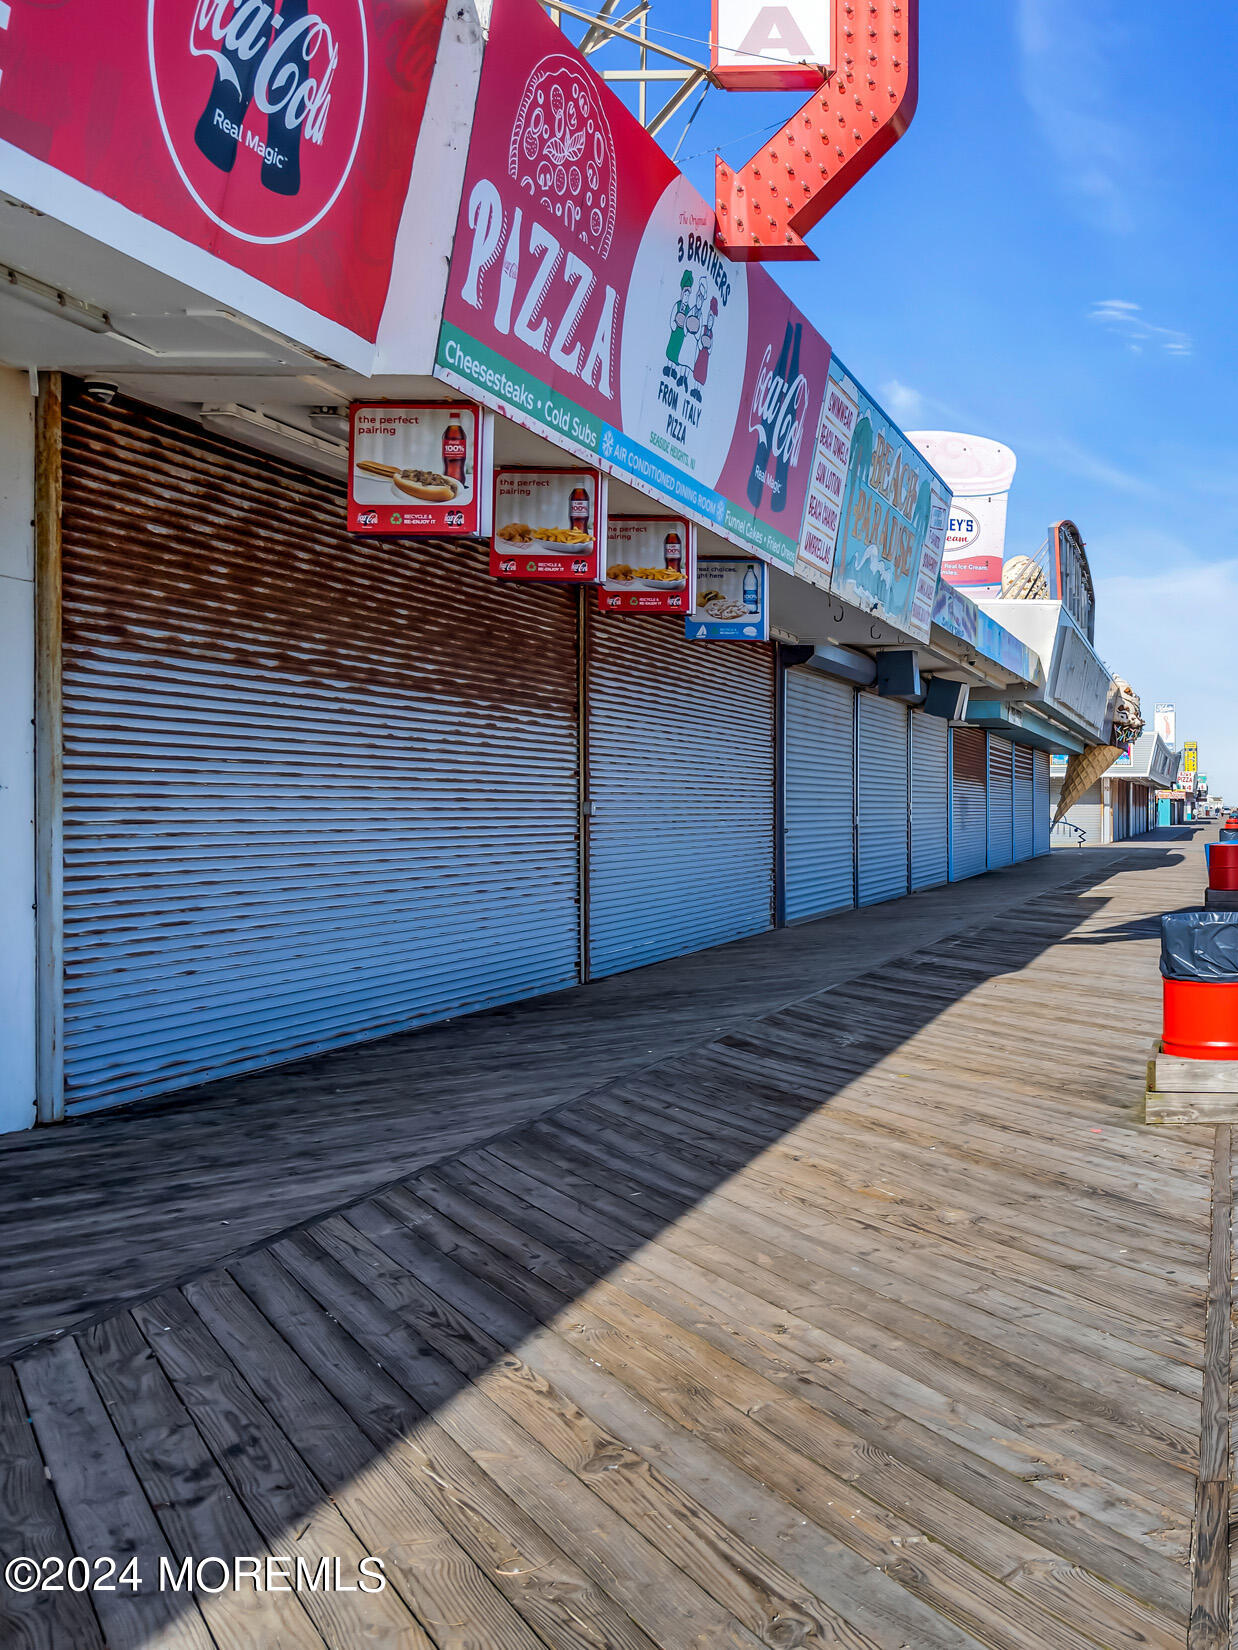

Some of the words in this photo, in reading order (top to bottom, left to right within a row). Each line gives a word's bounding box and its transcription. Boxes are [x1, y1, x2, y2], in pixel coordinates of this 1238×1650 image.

[735, 6, 815, 56] A
[213, 108, 243, 142] Real
[245, 130, 280, 168] Magic
[461, 179, 620, 400] PIZZA
[677, 236, 684, 263] 3
[687, 232, 731, 307] BROTHERS
[445, 340, 535, 410] Cheesesteaks
[545, 400, 569, 431] Cold
[571, 417, 597, 448] Subs
[658, 381, 679, 412] FROM
[682, 398, 702, 428] ITALY
[749, 344, 809, 467] Coca-Cola
[828, 391, 854, 431] SWIMWEAR
[358, 416, 376, 424] the
[380, 416, 419, 426] perfect
[358, 426, 396, 436] pairing
[666, 414, 687, 445] PIZZA
[649, 431, 670, 455] SEASIDE
[819, 423, 832, 451] BEACH
[833, 434, 850, 466] TOWELS
[499, 487, 531, 496] pairing
[517, 479, 550, 488] perfect
[612, 445, 628, 463] AIR
[628, 452, 675, 493] CONDITIONED
[675, 481, 697, 503] DINING
[697, 494, 717, 514] ROOM
[754, 465, 766, 484] Real
[766, 474, 783, 494] Magic
[816, 461, 826, 486] SUN
[825, 467, 842, 497] LOTION
[870, 432, 919, 522] BEACH
[808, 494, 822, 522] BEACH
[608, 533, 632, 541] airing
[724, 511, 745, 534] Funnel
[744, 523, 763, 544] Cakes
[766, 535, 781, 552] Fried
[804, 531, 832, 565] UMBRELLAS
[852, 488, 915, 582] PARADISE
